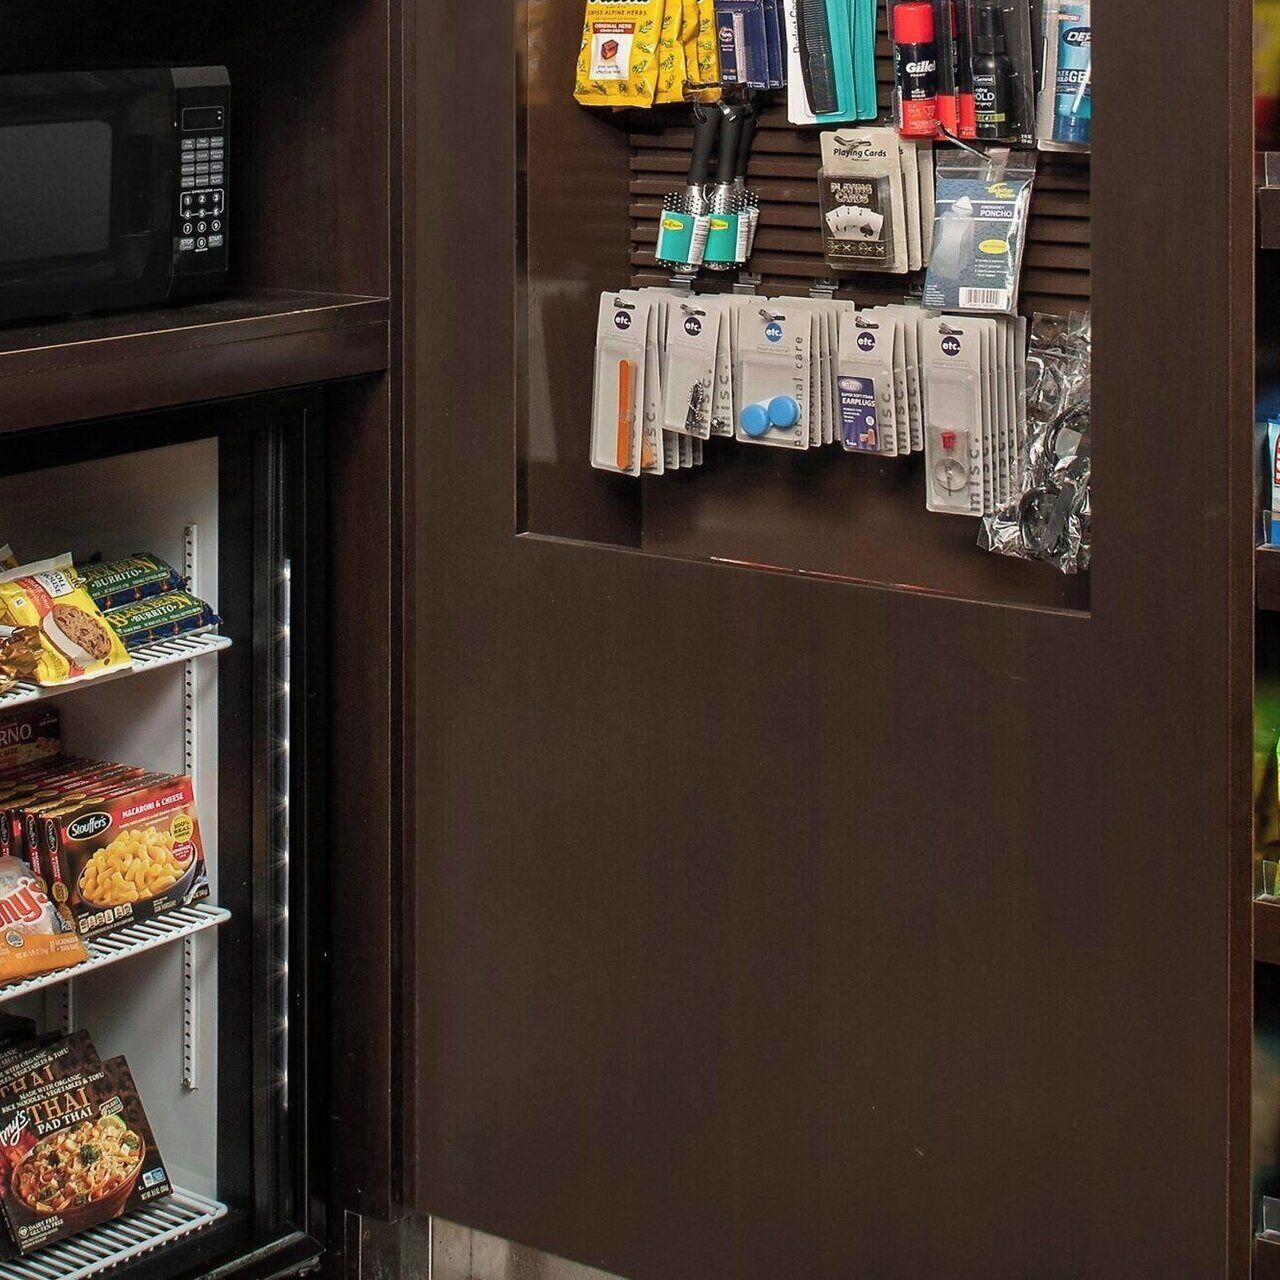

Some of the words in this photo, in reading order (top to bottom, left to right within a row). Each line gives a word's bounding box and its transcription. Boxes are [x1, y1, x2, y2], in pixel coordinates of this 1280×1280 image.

[833, 148, 863, 158] Playing
[864, 149, 887, 158] Cards
[830, 182, 873, 196] PLAYING
[834, 192, 870, 204] CARDS
[980, 209, 1012, 218] PONCHO
[795, 336, 804, 369] care
[842, 397, 875, 407] EARPLUGS
[122, 803, 155, 819] MACARONI
[162, 792, 185, 805] CHEESE
[71, 815, 108, 837] Stouffer's
[38, 1084, 55, 1096] WITH
[54, 1073, 82, 1090] ORGANIC
[89, 1071, 105, 1083] TOFU
[27, 1087, 92, 1126] THAI
[37, 1118, 62, 1135] PAD
[61, 1106, 93, 1126] THAI
